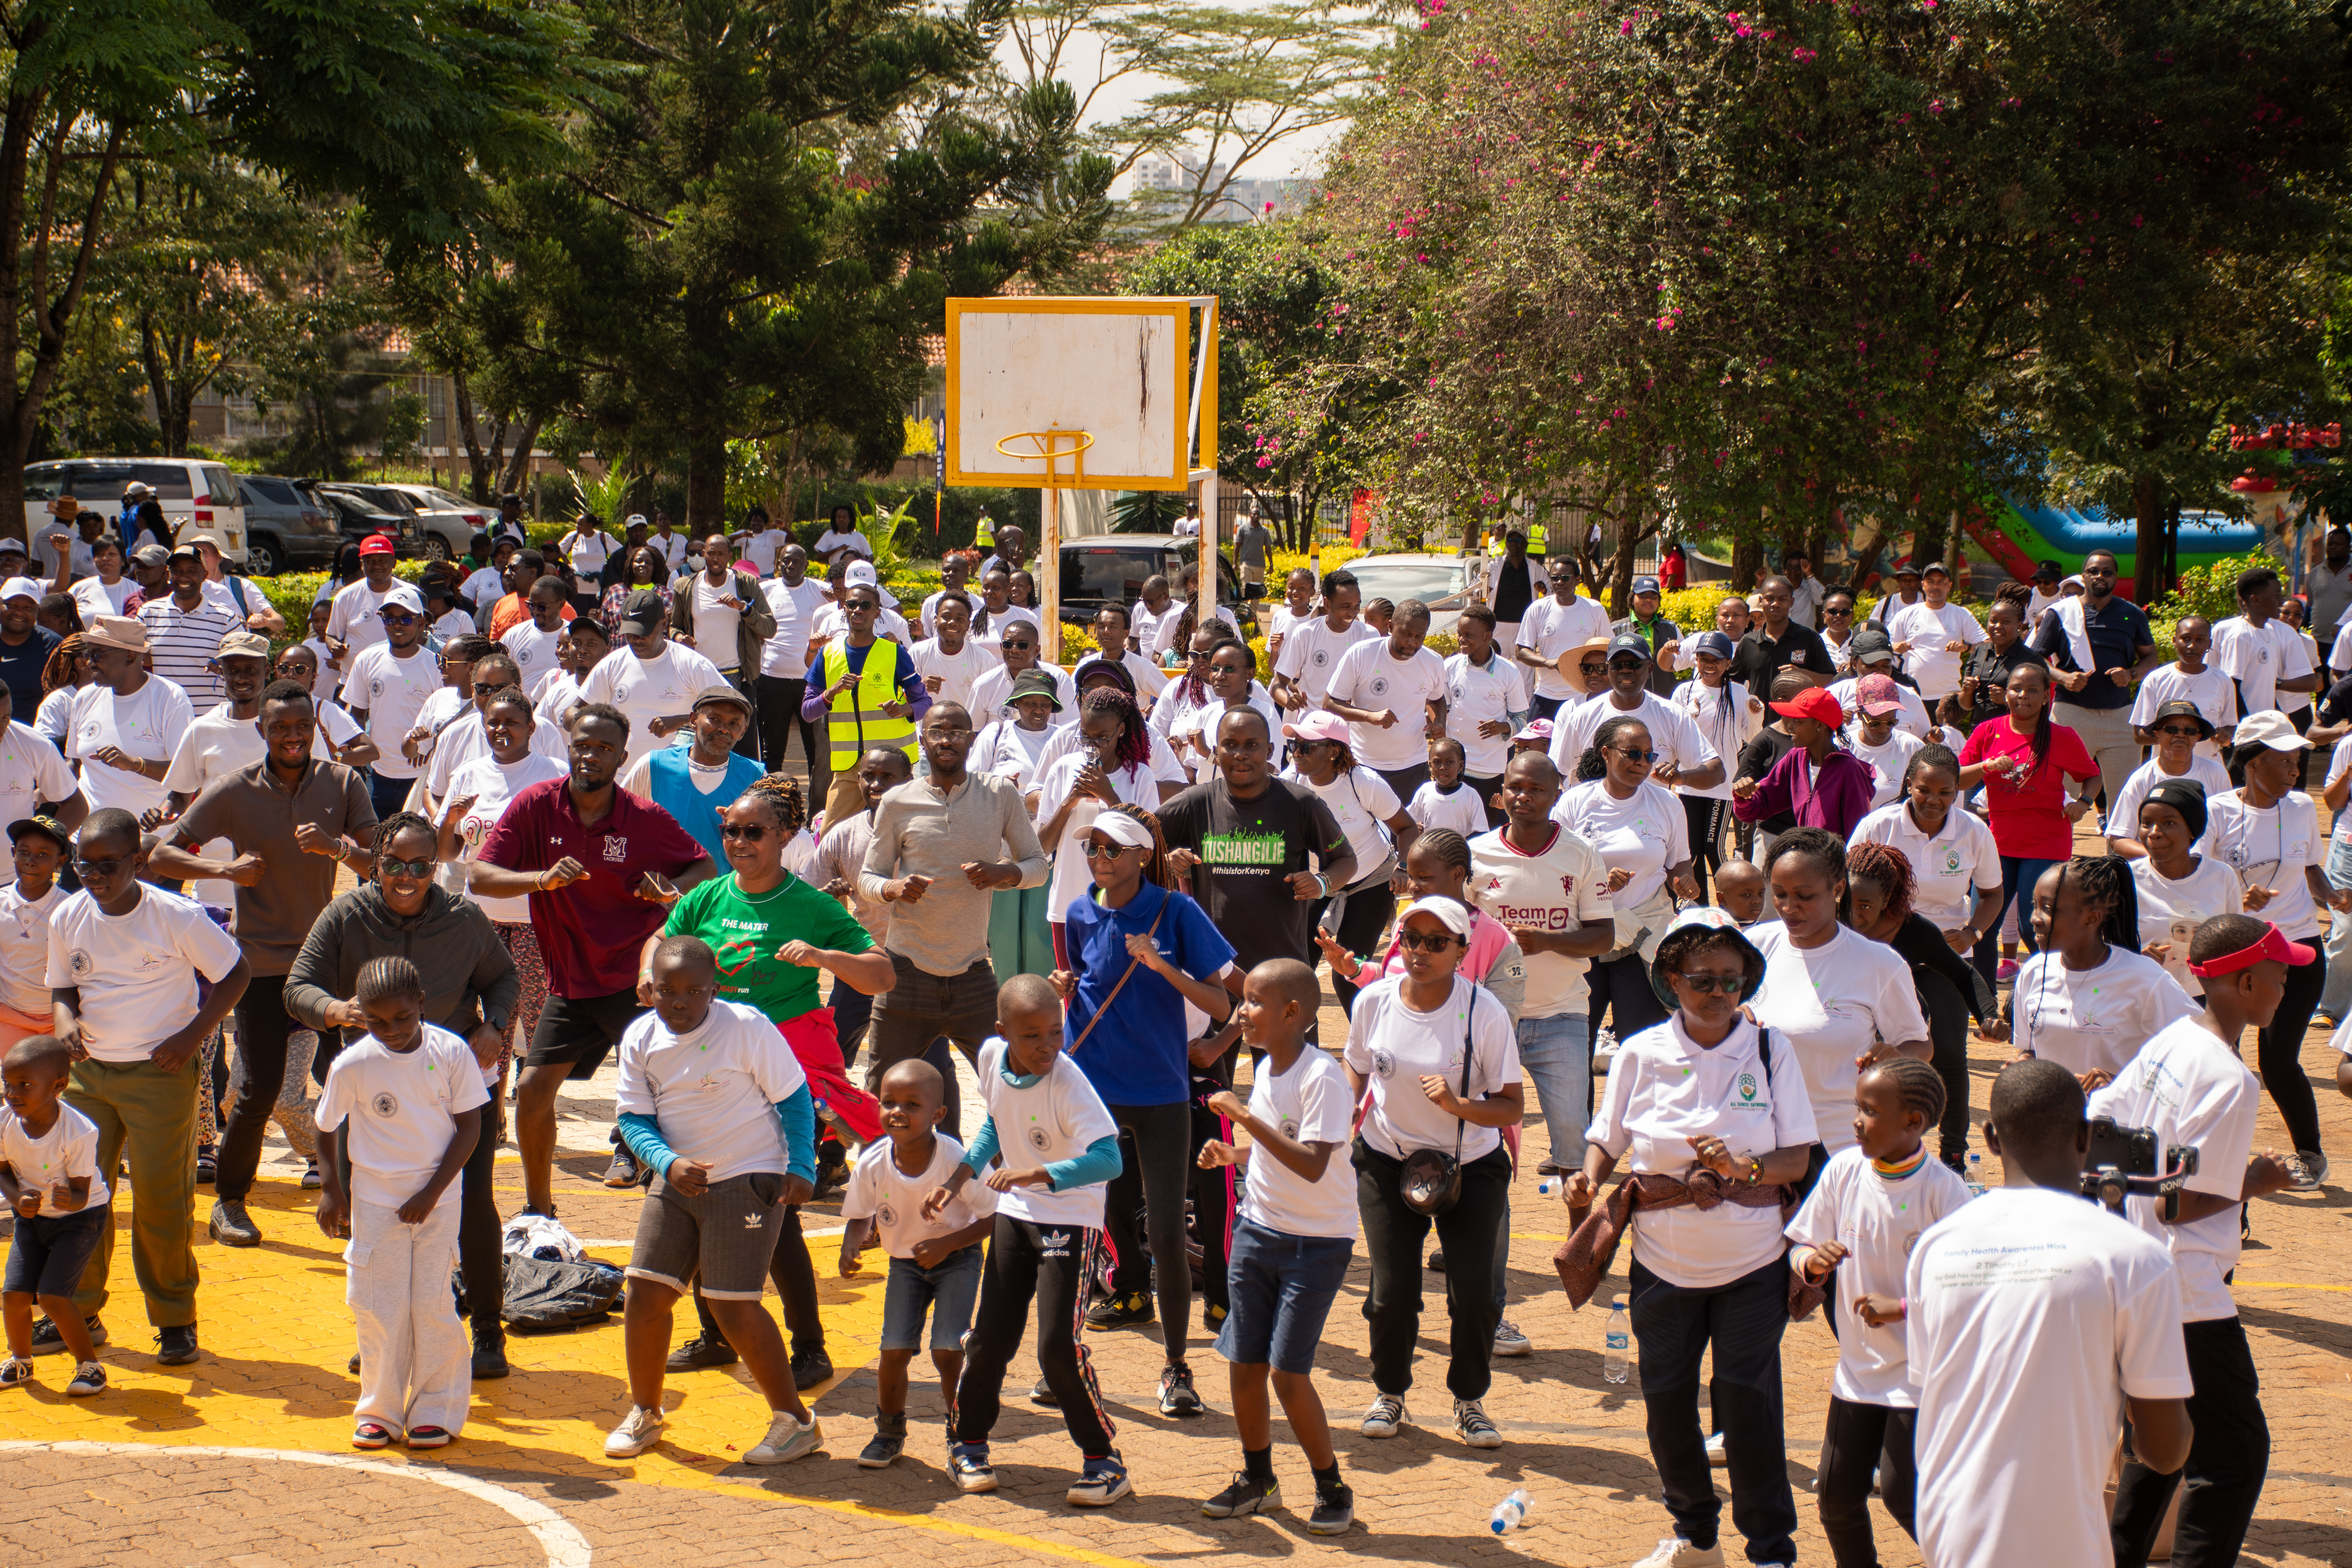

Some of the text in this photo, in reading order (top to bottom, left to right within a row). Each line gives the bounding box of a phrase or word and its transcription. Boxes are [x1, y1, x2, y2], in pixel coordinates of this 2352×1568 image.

[1202, 841, 1284, 863] TUSHANGILIE
[1212, 867, 1270, 876] #thisisforKenya
[1498, 905, 1546, 919] Team
[721, 918, 769, 931] THE MATER
[1043, 1249, 1070, 1257] adidas
[1944, 1249, 1969, 1257] Family
[2001, 1244, 2044, 1254] Awareness
[2047, 1242, 2067, 1250] Walk
[1984, 1260, 2016, 1270] Timothy
[1983, 1271, 1999, 1280] given
[2012, 1269, 2028, 1277] spirit
[1941, 1282, 1960, 1290] power
[2020, 1276, 2038, 1284] sound
